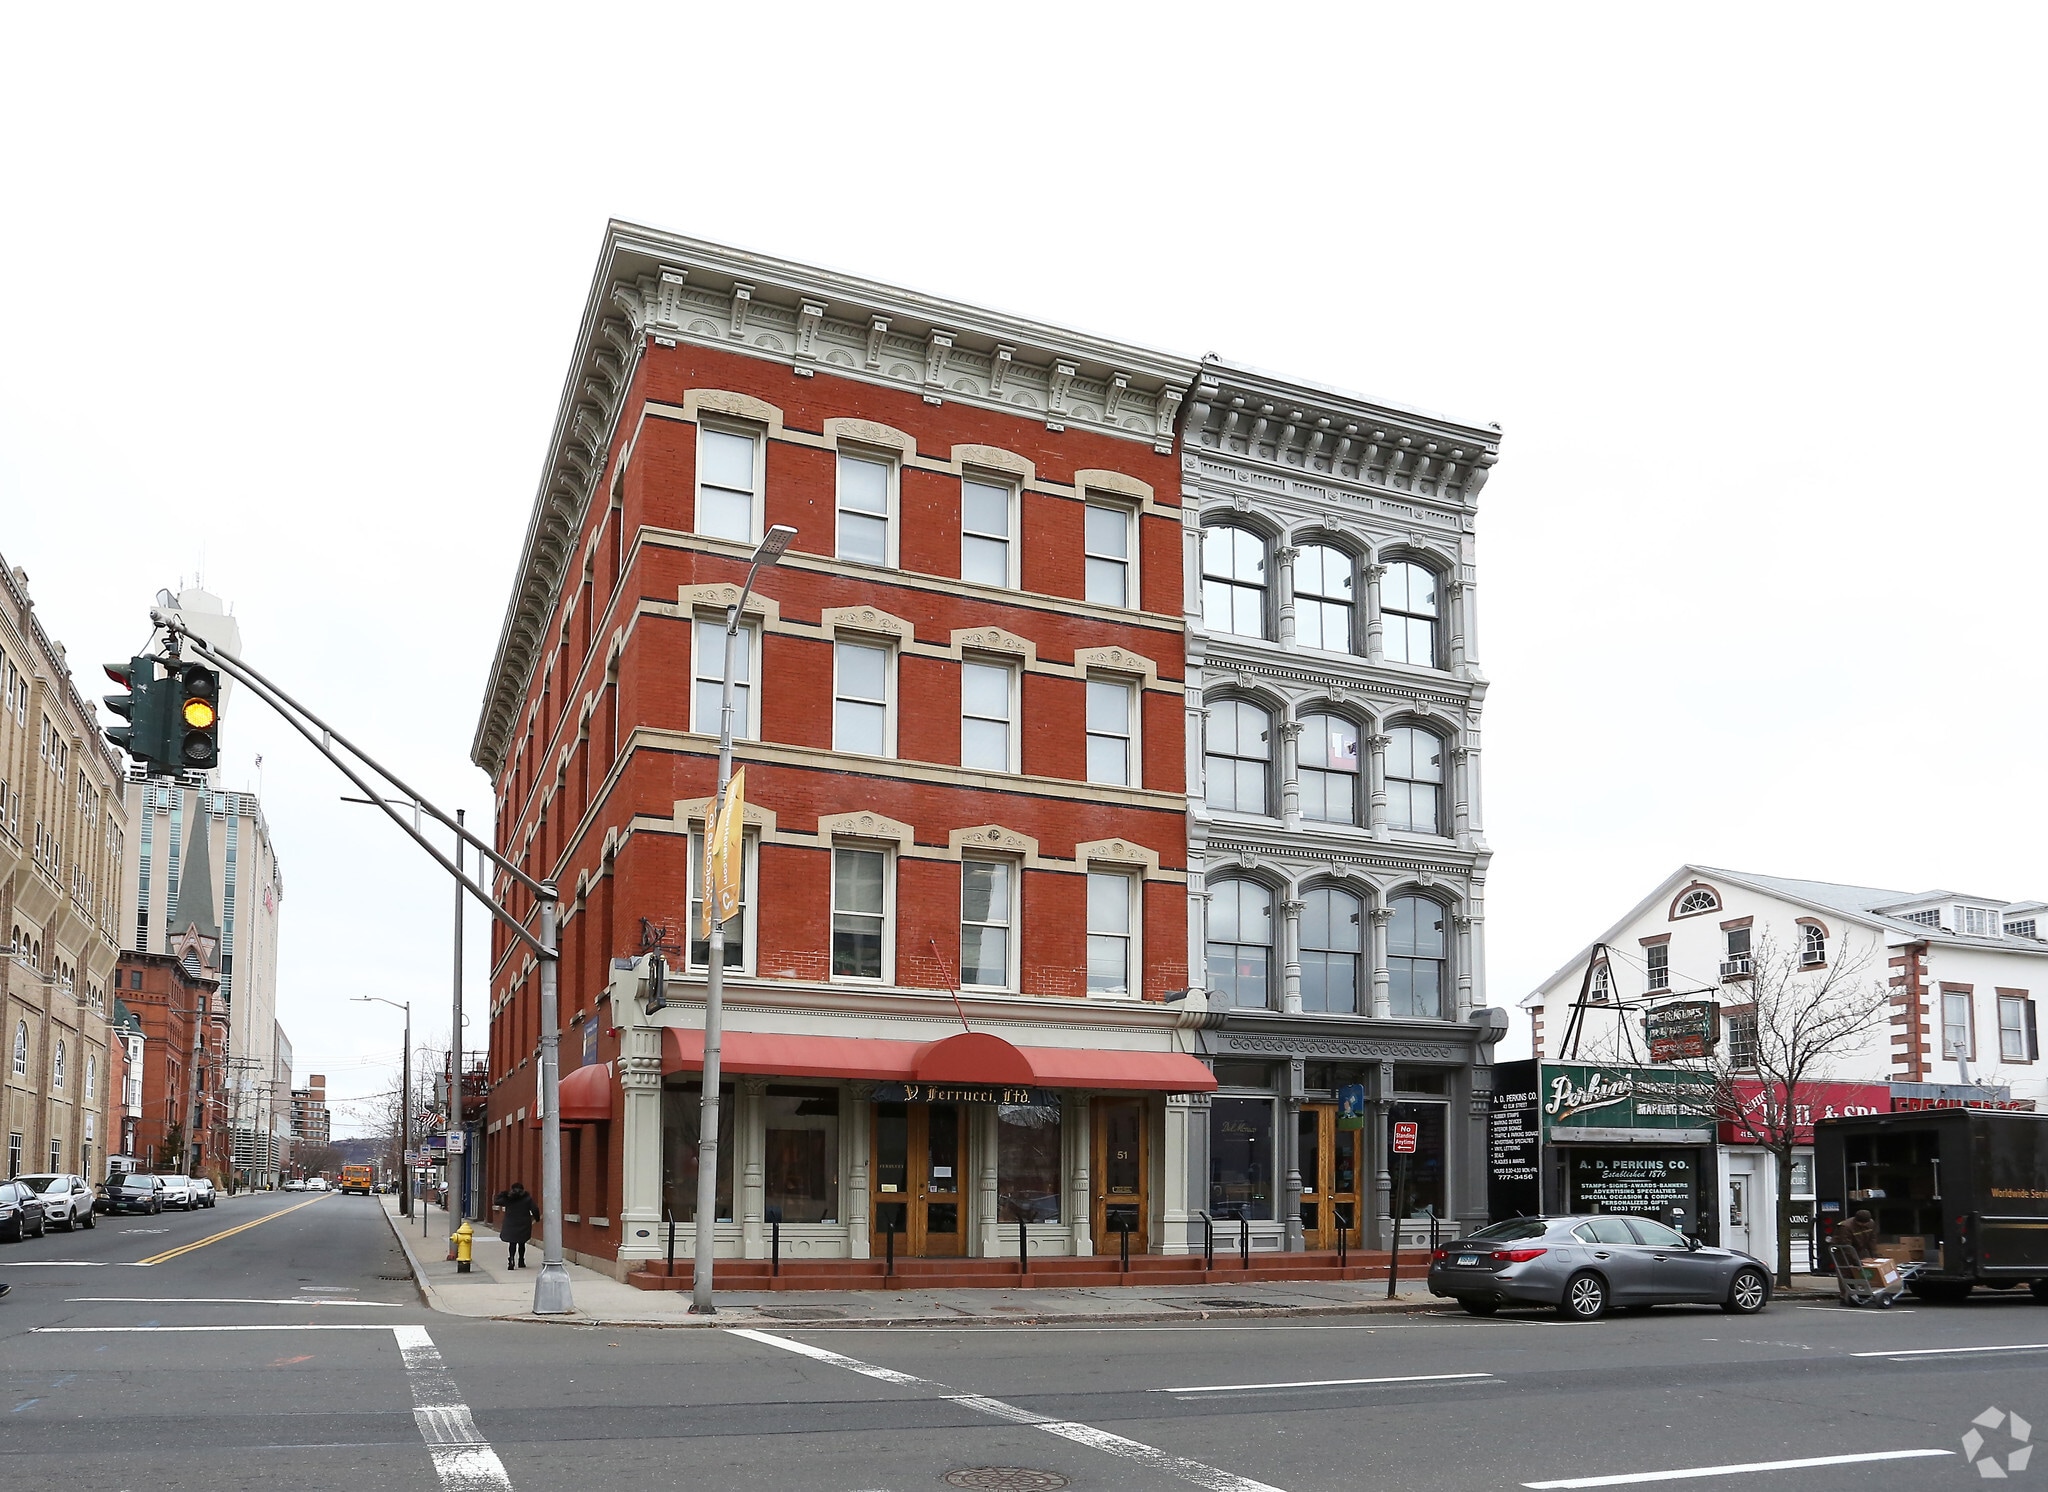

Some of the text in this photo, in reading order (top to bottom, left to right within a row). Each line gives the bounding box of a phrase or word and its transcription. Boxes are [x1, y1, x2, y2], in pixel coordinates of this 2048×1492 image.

[1001, 1088, 1031, 1105] Ltd.
[1506, 1093, 1527, 1102] PERKINS
[1528, 1091, 1538, 1101] CO.
[1545, 1073, 1633, 1114] Perkins
[1739, 1087, 1776, 1121] ASHIO
[1396, 1132, 1415, 1140] Standing
[1117, 1150, 1128, 1160] 51
[1579, 1160, 1689, 1169] A. D. PERKINS CO.
[1602, 1170, 1667, 1179] Established 1876
[1990, 1187, 2030, 1199] Worldwide
